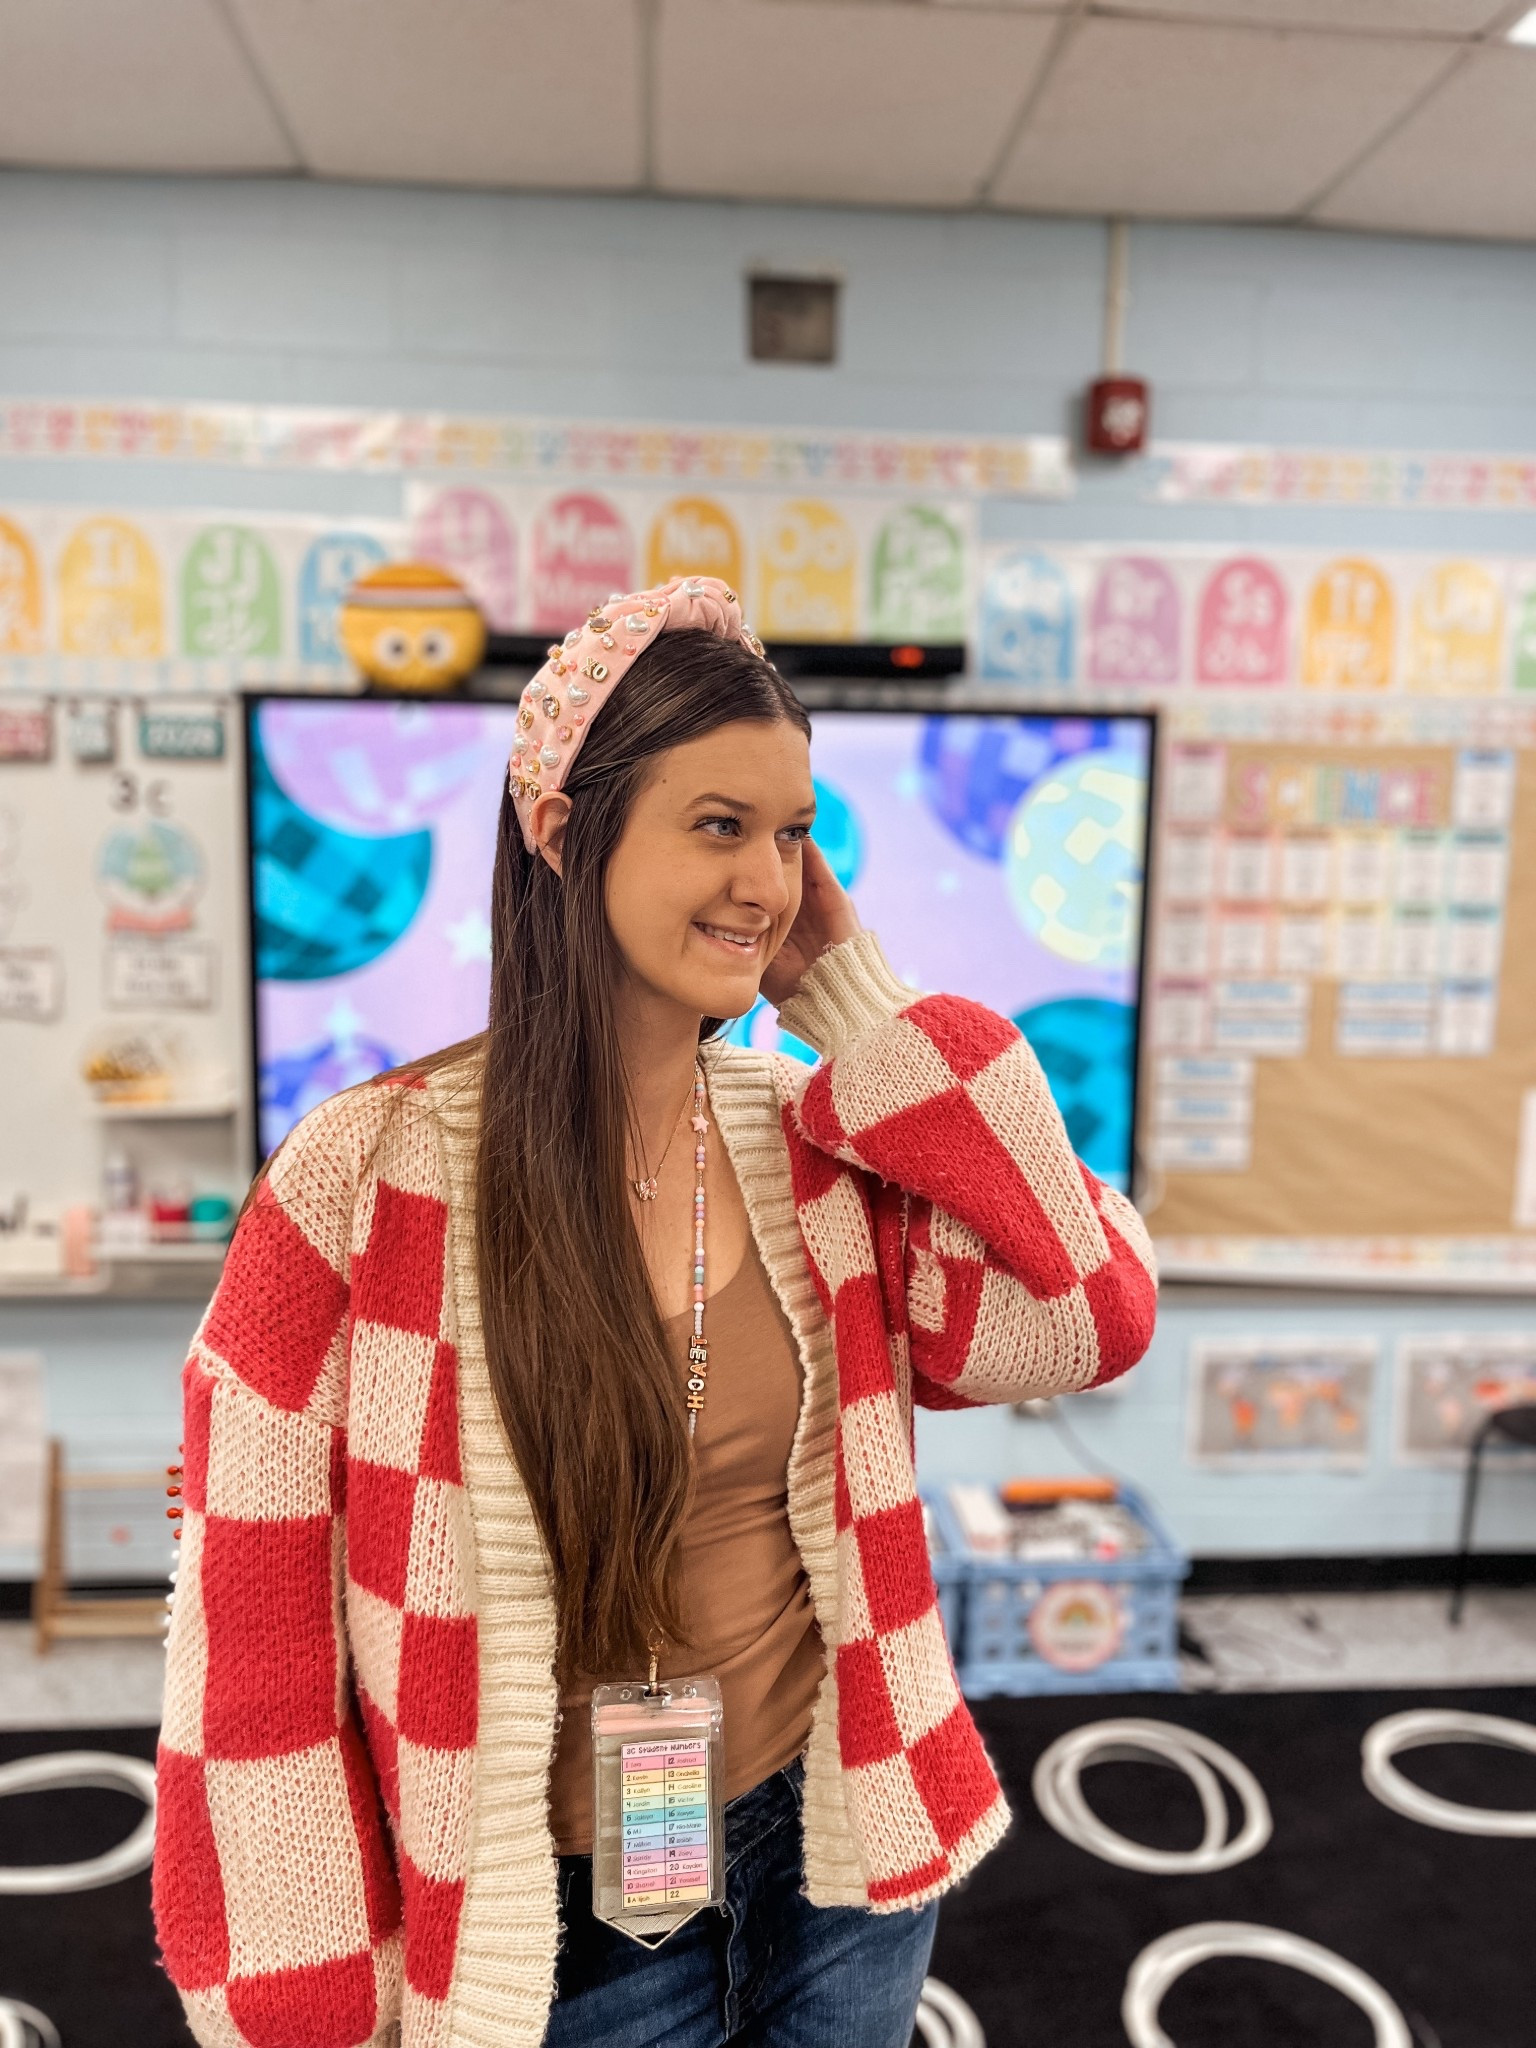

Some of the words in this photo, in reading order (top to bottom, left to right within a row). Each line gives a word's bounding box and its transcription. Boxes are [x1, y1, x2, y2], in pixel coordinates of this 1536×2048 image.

[580, 656, 609, 683] XO
[110, 772, 140, 814] 3
[1237, 763, 1440, 826] SCIENCE
[638, 1744, 668, 1754] Student
[670, 1741, 701, 1751] Numbers
[668, 1756, 675, 1764] 12
[626, 1774, 631, 1782] 2
[668, 1770, 675, 1778] 13
[668, 1796, 675, 1804] 15
[668, 1809, 676, 1817] 16
[626, 1828, 632, 1836] 6
[669, 1863, 680, 1871] 20
[670, 1876, 677, 1885] 21
[628, 1882, 634, 1890] 10
[670, 1890, 680, 1898] 22
